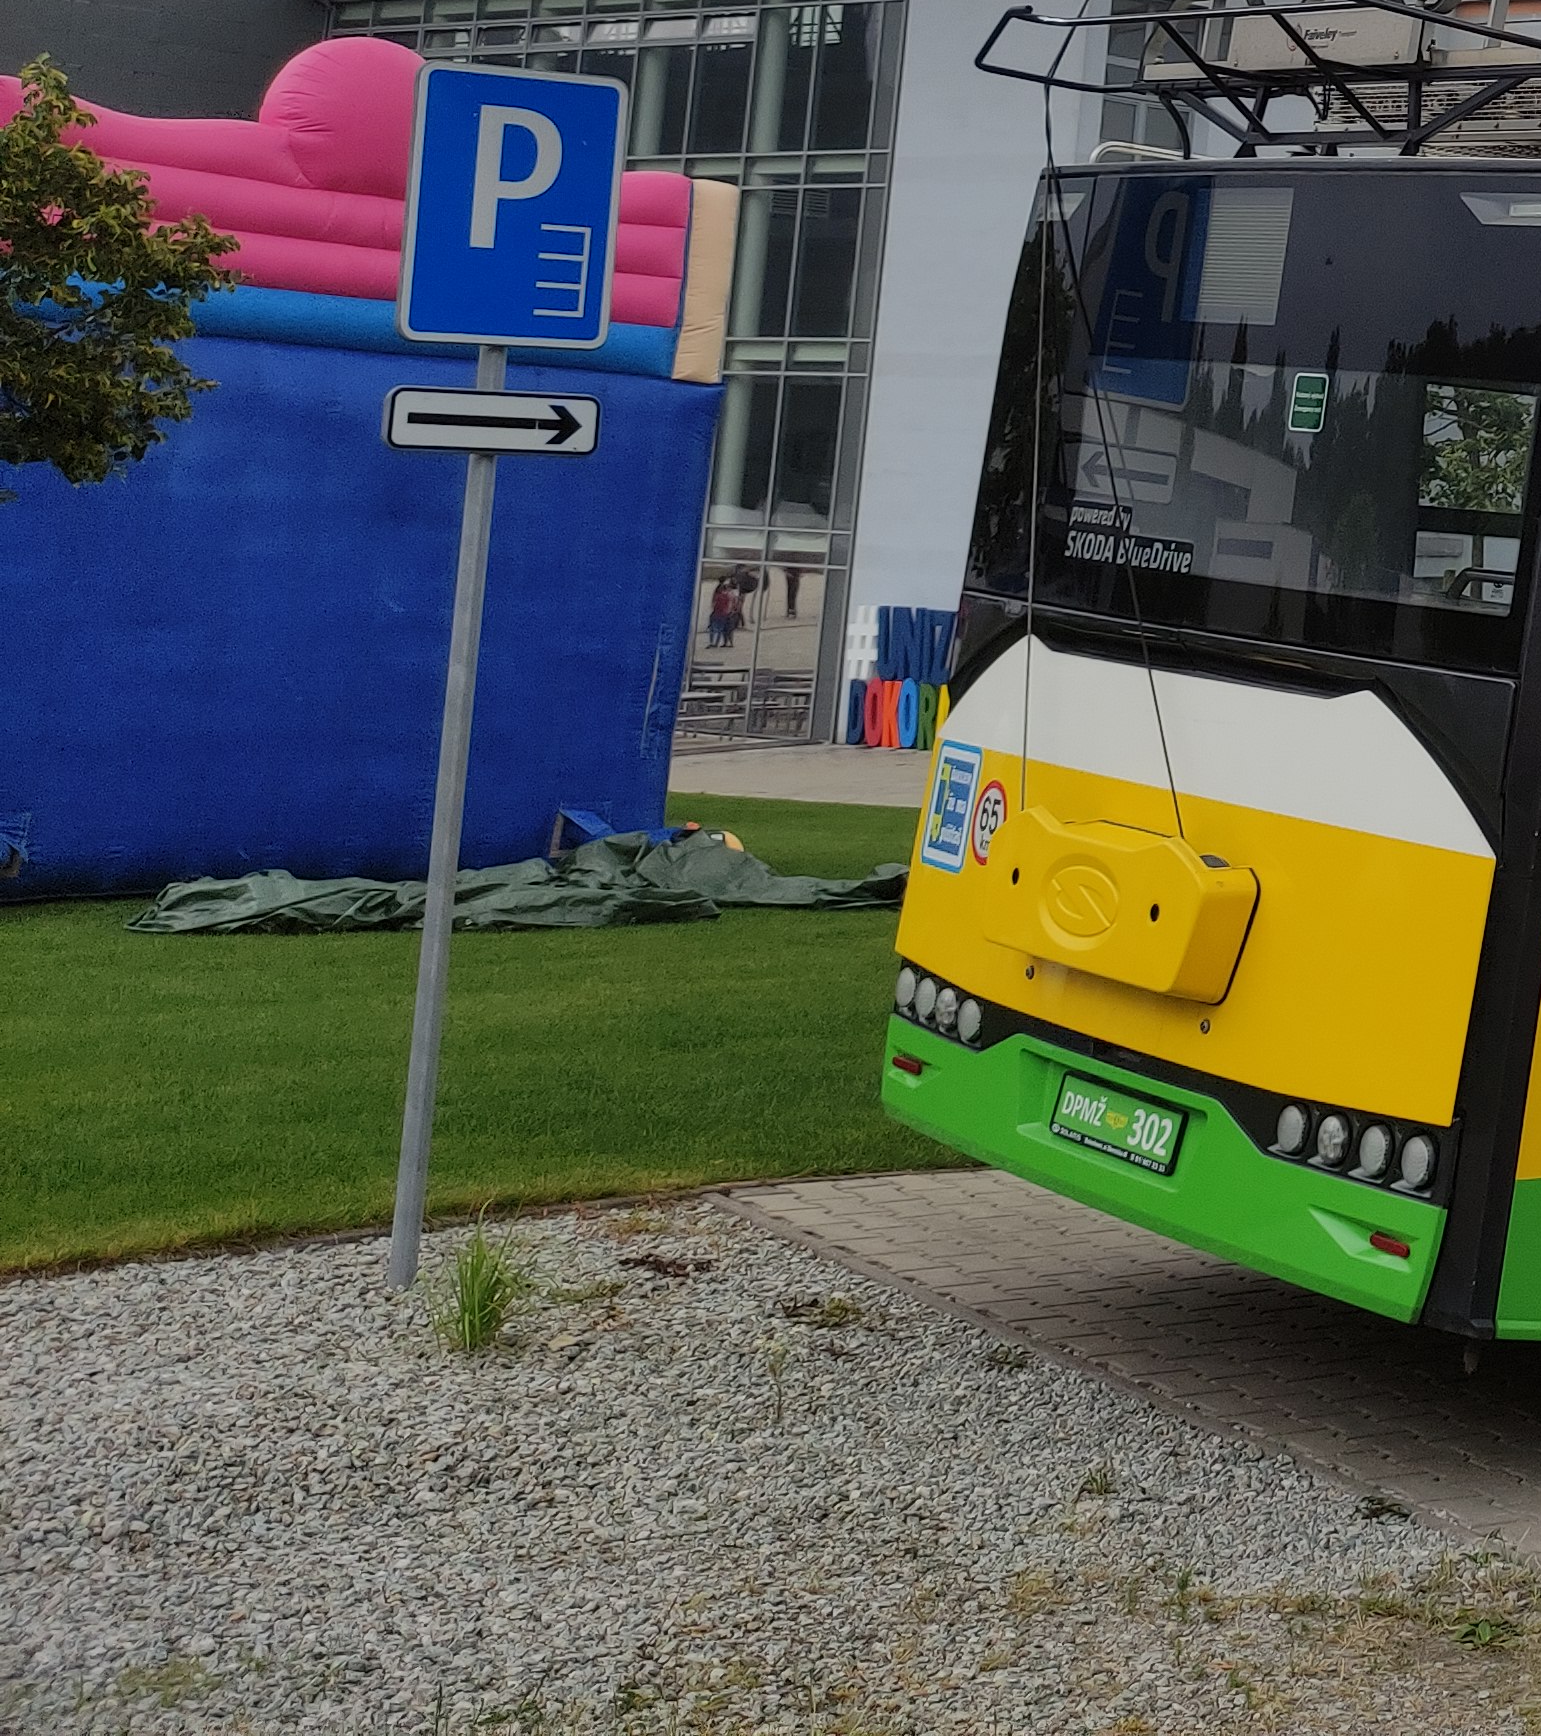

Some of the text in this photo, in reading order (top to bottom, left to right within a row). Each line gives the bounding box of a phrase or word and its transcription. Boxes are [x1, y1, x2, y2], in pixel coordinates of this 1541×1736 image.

[469, 104, 562, 249] P
[1068, 505, 1117, 527] powered
[1115, 537, 1192, 574] BlueDrive
[979, 795, 1002, 835] 65
[1061, 1091, 1109, 1127] DPMŽ
[1126, 1108, 1173, 1157] 302
